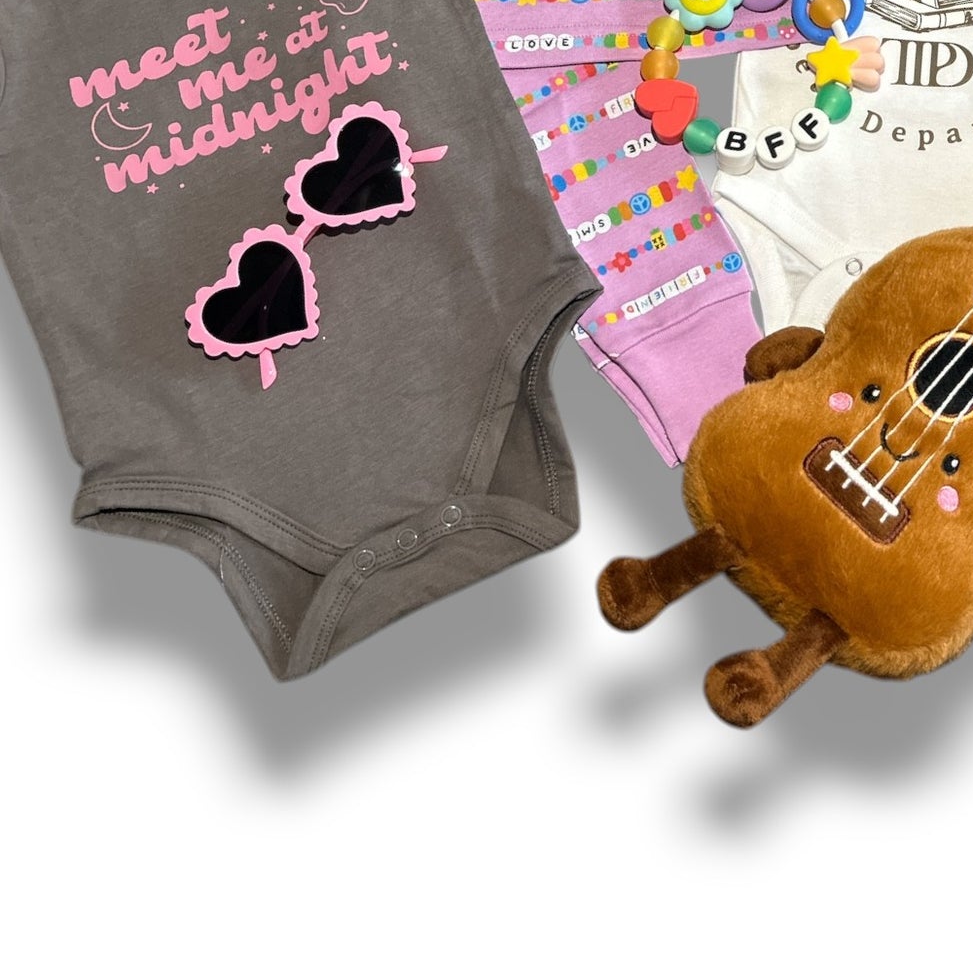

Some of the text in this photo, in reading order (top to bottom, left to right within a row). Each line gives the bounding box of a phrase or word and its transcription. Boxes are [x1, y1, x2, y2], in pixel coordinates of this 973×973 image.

[69, 7, 231, 108] meet
[178, 9, 329, 109] me at
[510, 38, 571, 50] LOVE
[103, 30, 393, 194] midnight
[724, 112, 819, 159] BFF
[626, 269, 701, 314] FRIEND
